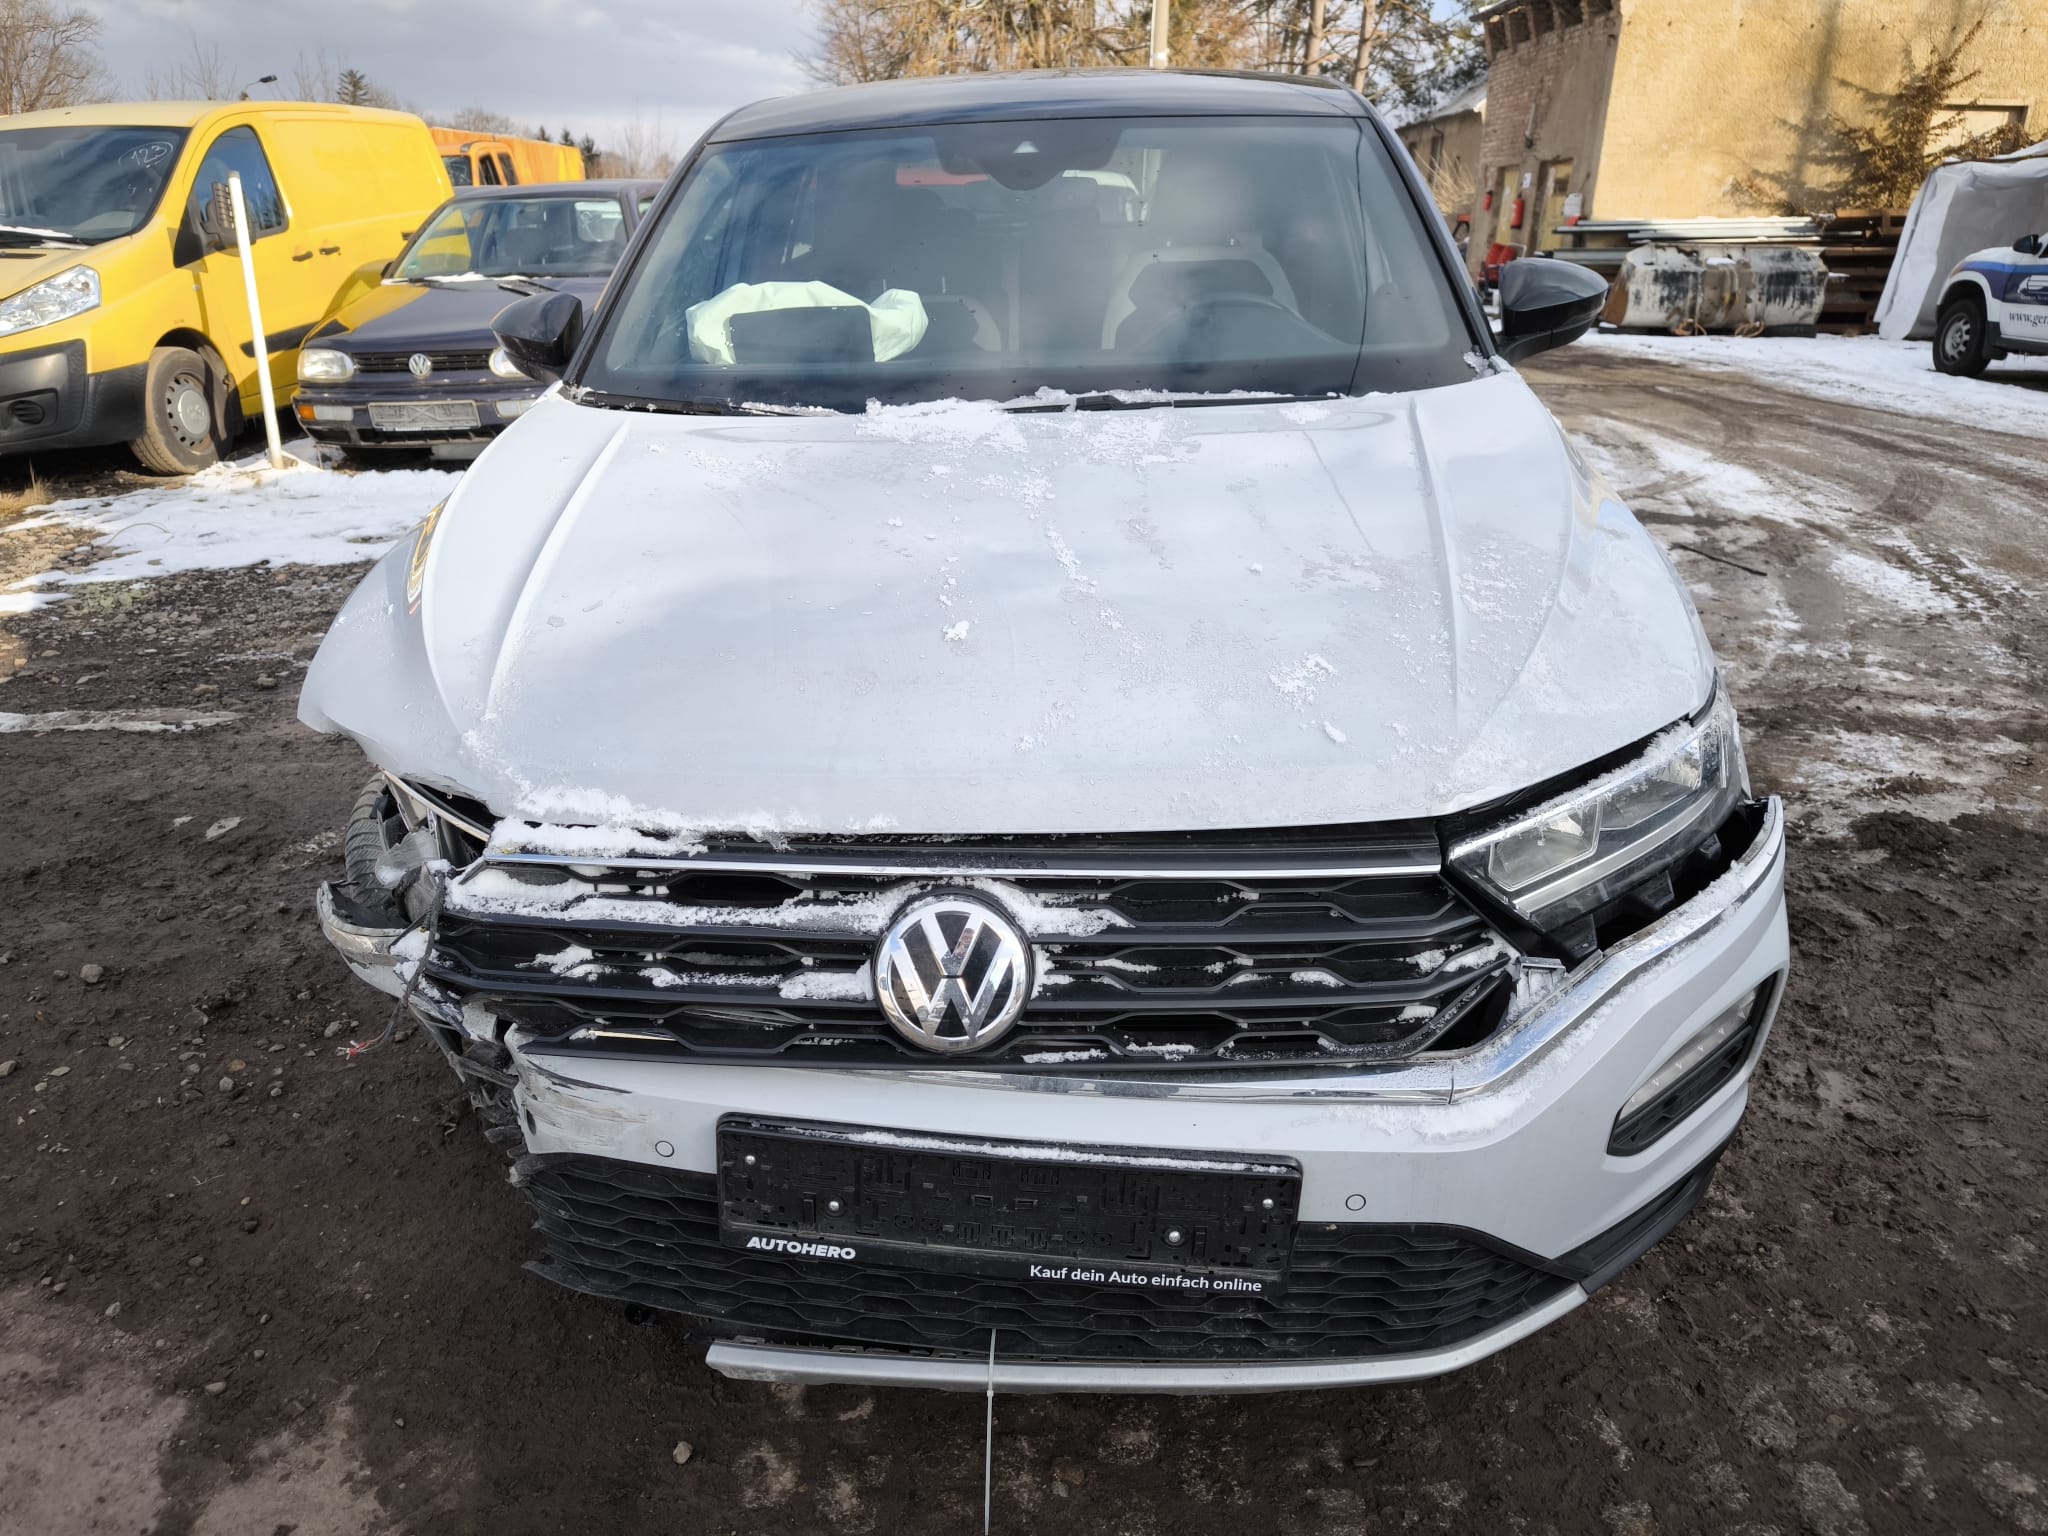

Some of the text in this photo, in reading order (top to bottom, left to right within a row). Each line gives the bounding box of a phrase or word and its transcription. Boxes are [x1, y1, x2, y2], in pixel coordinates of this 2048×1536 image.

[131, 145, 168, 166] 123
[880, 902, 1022, 1046] VW
[746, 1236, 856, 1260] AUTOHERO
[1030, 1264, 1262, 1292] Kauf dein Auto einfach online
